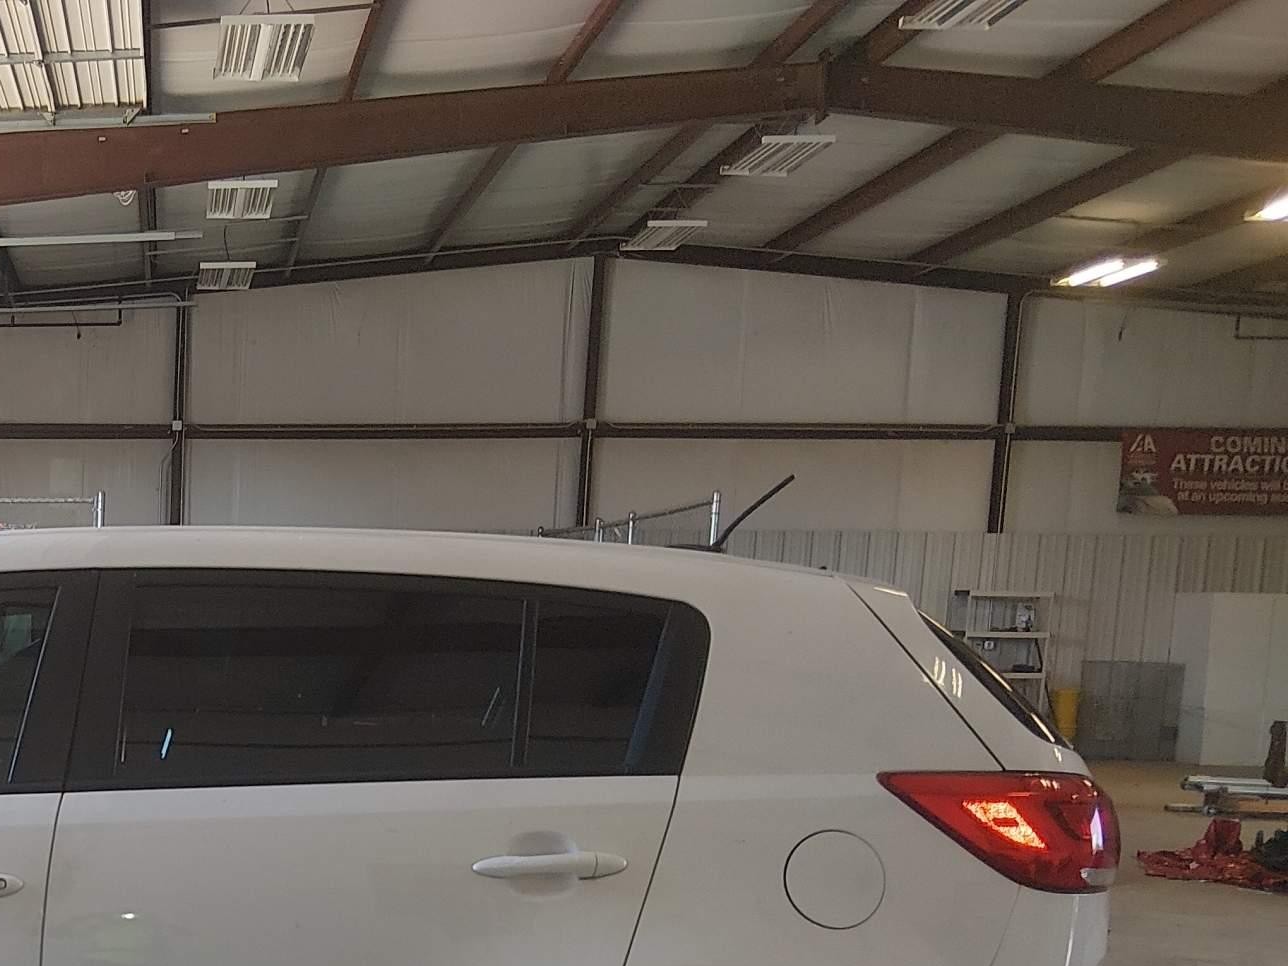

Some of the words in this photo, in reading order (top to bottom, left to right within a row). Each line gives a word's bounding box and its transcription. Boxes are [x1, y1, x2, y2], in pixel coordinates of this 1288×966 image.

[1210, 436, 1288, 453] COMIN
[1173, 478, 1207, 490] These
[1210, 478, 1258, 491] vehicles
[1177, 490, 1190, 501] at
[1191, 491, 1205, 502] an
[1208, 490, 1268, 504] upcoming
